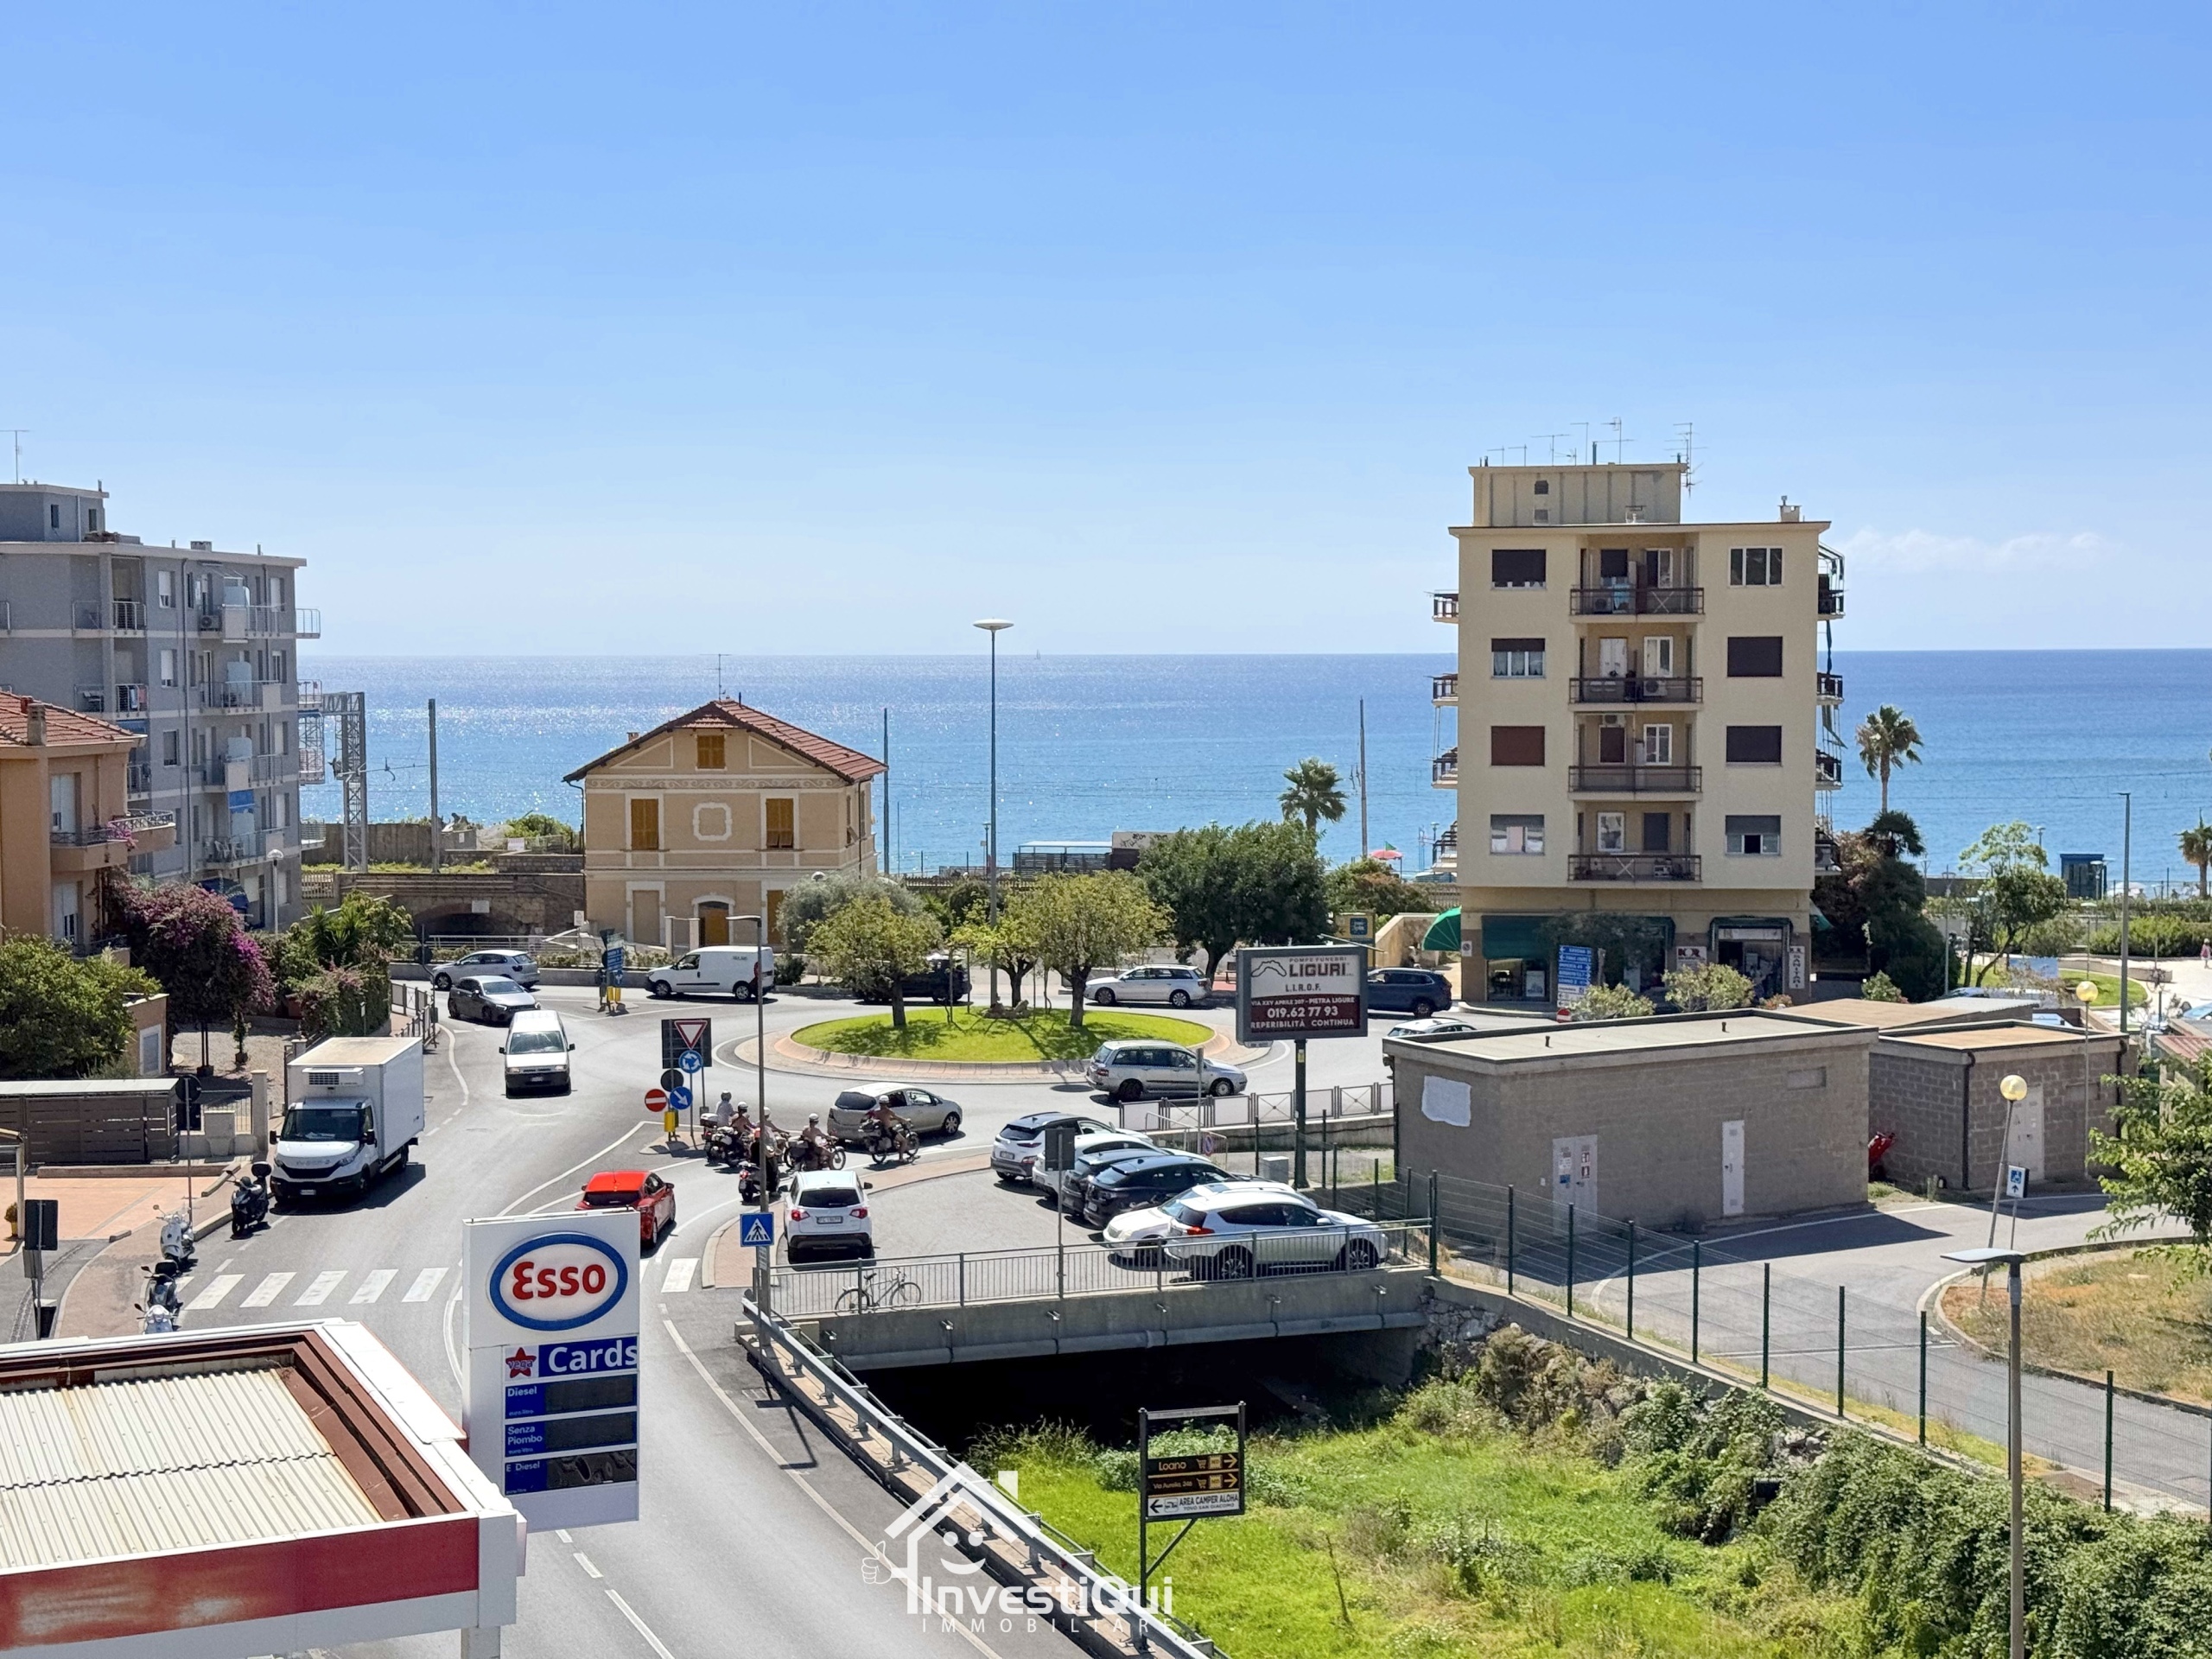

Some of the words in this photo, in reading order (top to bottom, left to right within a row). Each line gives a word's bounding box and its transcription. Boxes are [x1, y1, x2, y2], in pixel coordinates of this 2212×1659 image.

[1289, 963, 1346, 977] LIGURI
[1267, 1007, 1305, 1019] 019.62
[1308, 1007, 1321, 1017] 77
[1324, 1006, 1338, 1016] 93
[1251, 1019, 1306, 1028] REPERIBILITÀ
[549, 1340, 637, 1373] Cards
[507, 1359, 533, 1370] vega
[507, 1386, 537, 1397] Diesel
[507, 1426, 536, 1435] Senza
[507, 1435, 543, 1446] Piombo
[515, 1461, 540, 1471] Diesel
[1158, 1461, 1187, 1471] Loano
[1179, 1497, 1194, 1506] AREA
[1195, 1495, 1218, 1504] CAMPER
[1219, 1493, 1238, 1503] ALOHA
